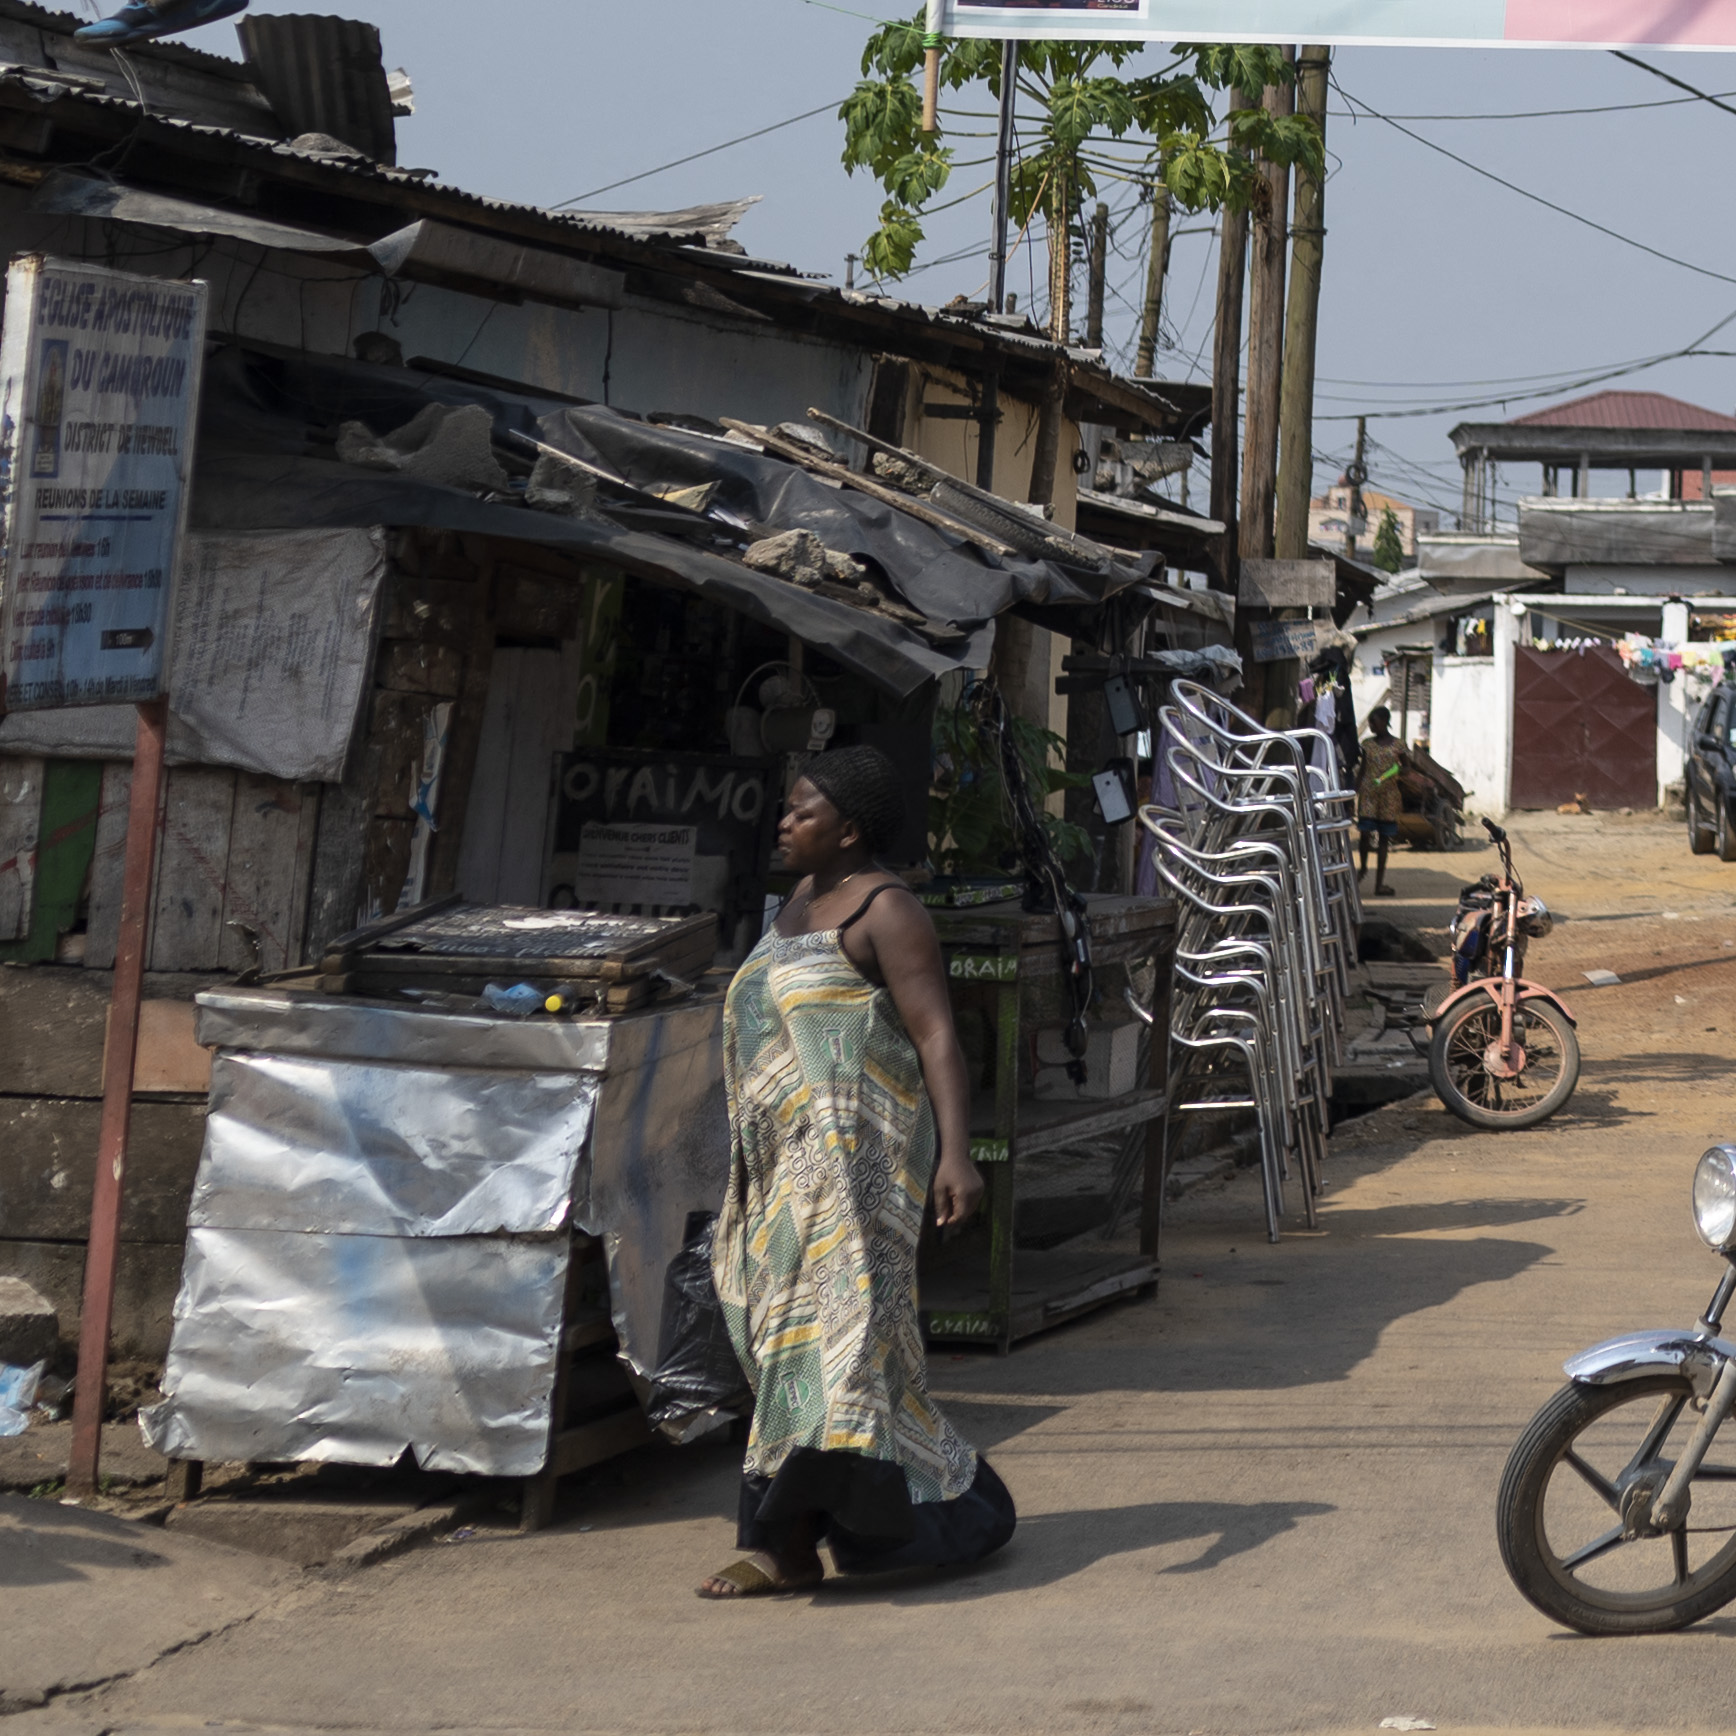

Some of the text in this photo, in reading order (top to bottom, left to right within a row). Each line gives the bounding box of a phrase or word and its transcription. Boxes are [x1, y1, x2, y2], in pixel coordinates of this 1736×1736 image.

[92, 286, 194, 342] APOSTOLIQUE
[70, 348, 186, 398] DU CAMEROUN
[64, 420, 114, 454] DISTRICT
[117, 423, 131, 454] DE
[35, 488, 166, 510] REUNIONS DE LA SEMAINE
[630, 831, 657, 844] CHERS
[657, 829, 690, 845] CLIENTS
